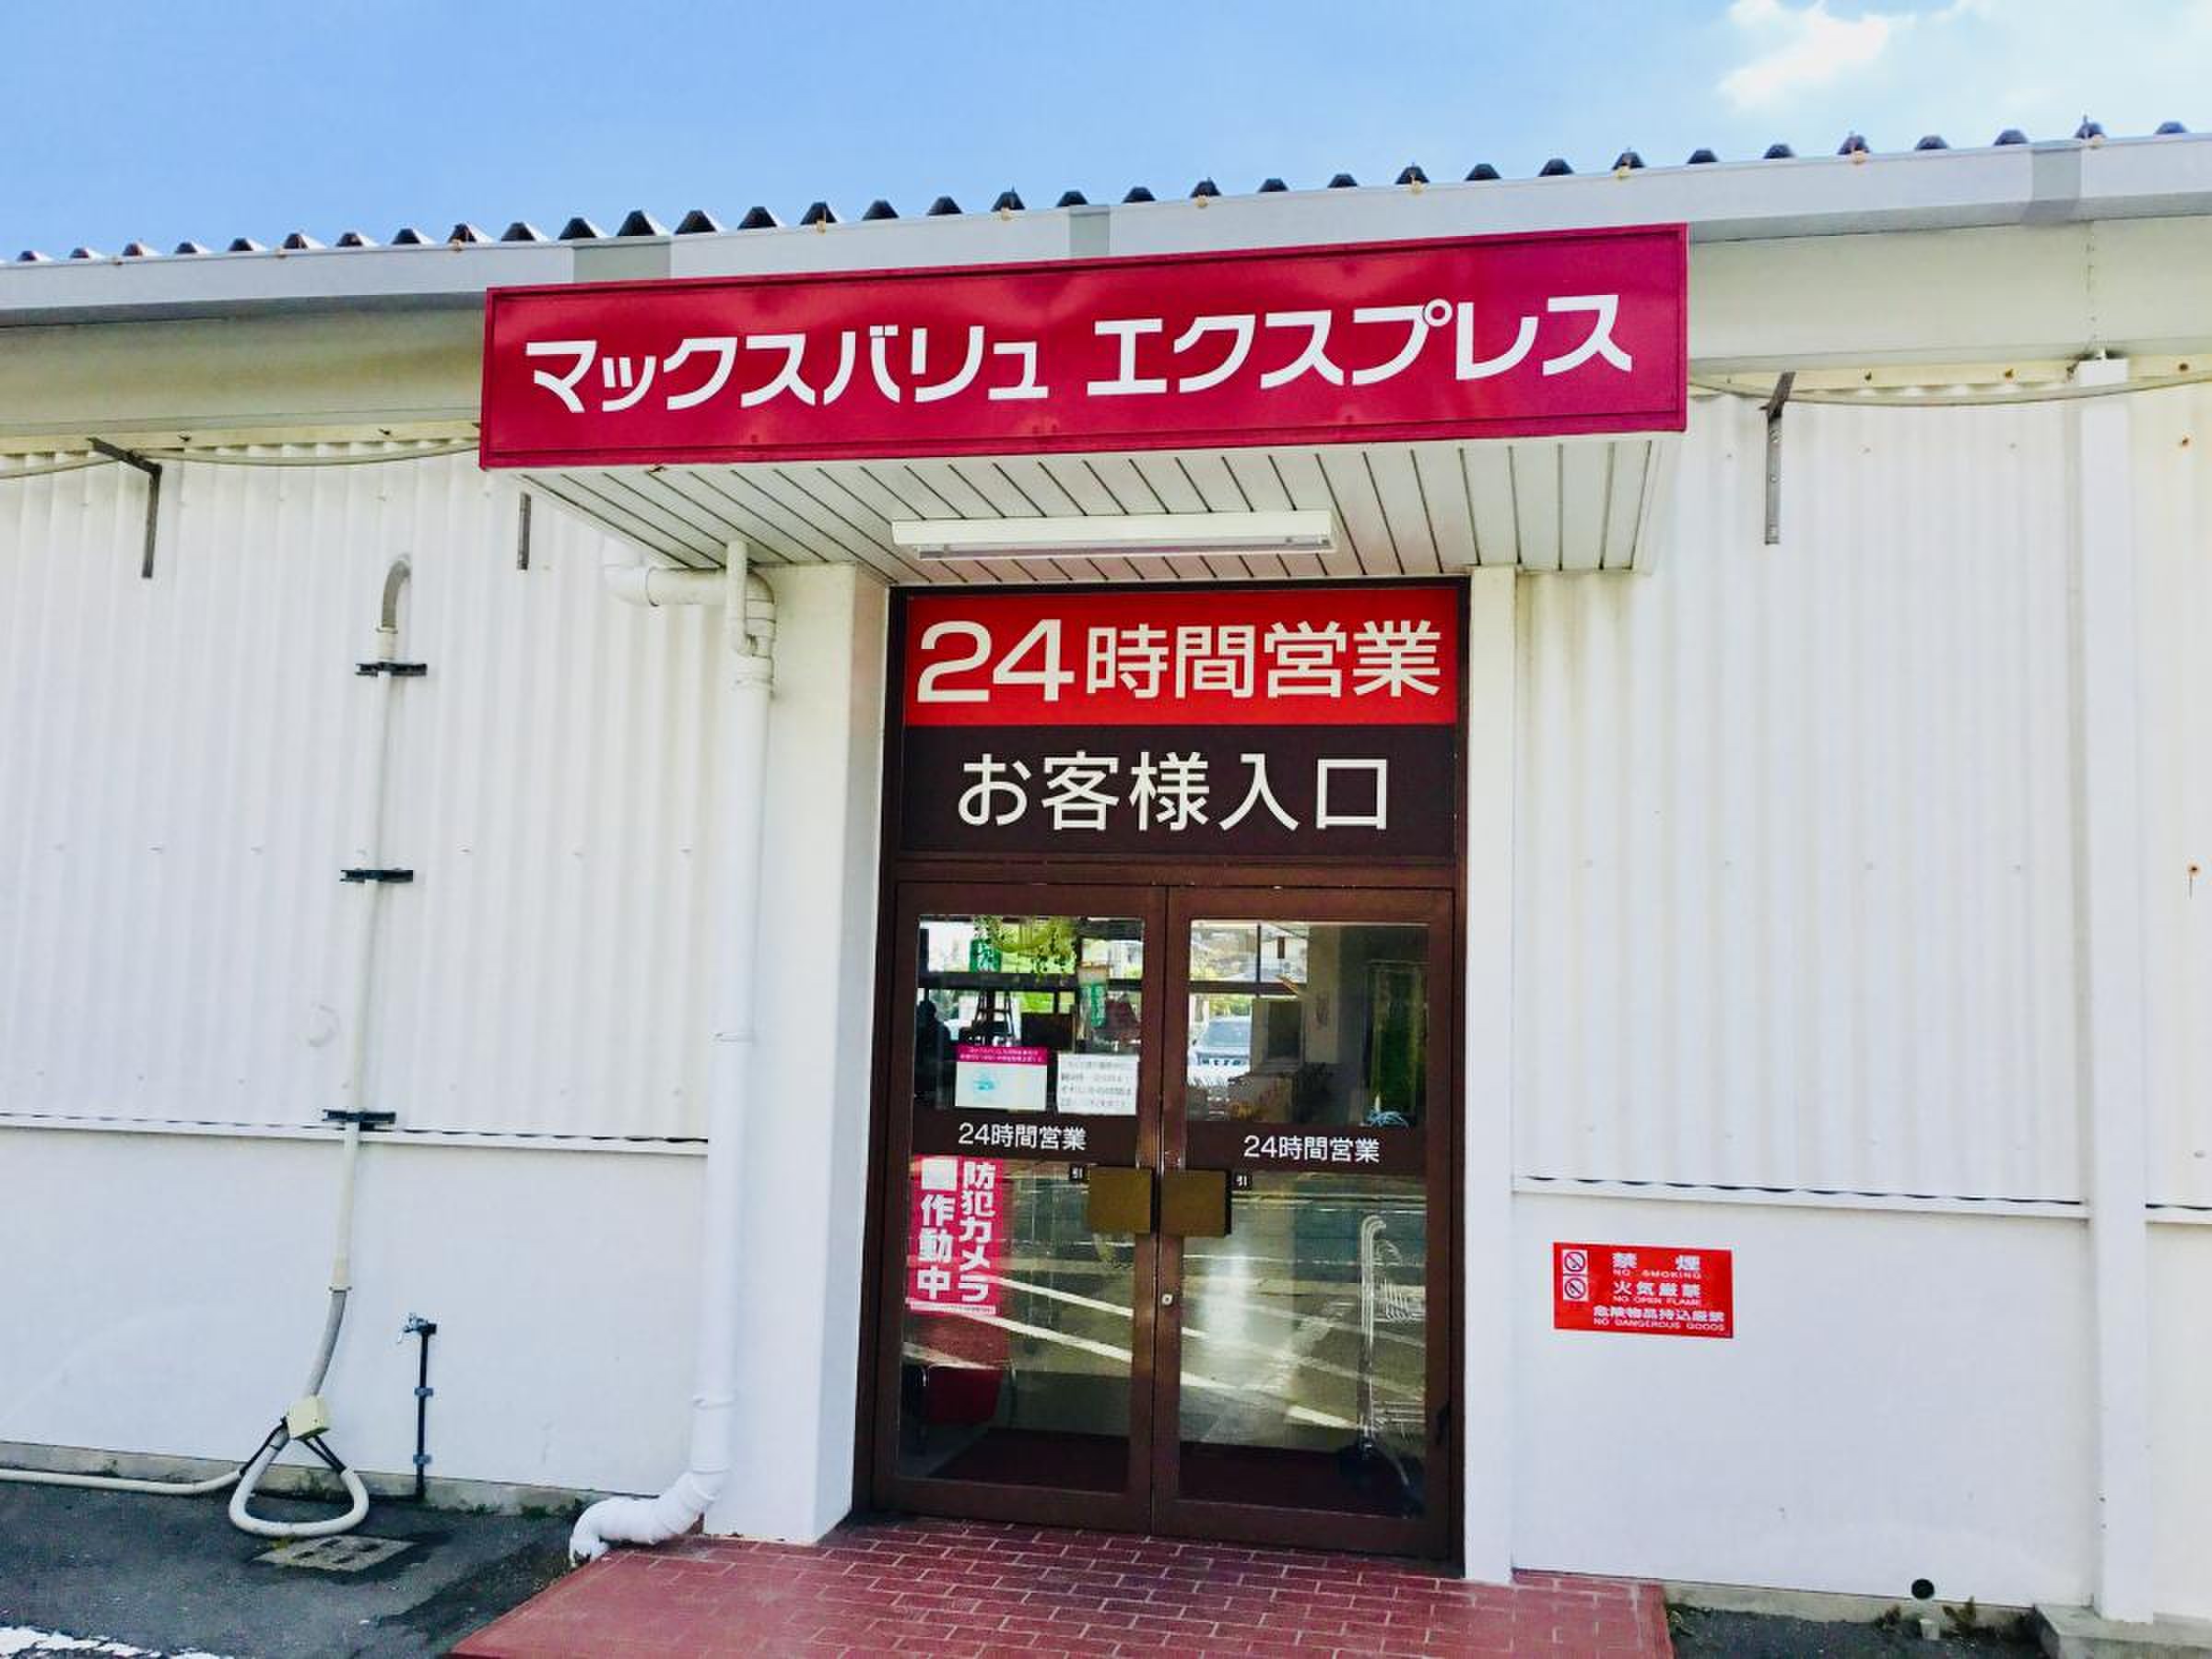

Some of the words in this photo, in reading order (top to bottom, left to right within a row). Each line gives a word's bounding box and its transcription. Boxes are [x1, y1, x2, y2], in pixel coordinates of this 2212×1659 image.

[526, 324, 1049, 414] マックスバリュ
[1087, 293, 1632, 396] エクスプレス
[917, 618, 1441, 702] 24時間営業
[958, 749, 1387, 831] お客様入口
[958, 1121, 1087, 1151] 24時間営業
[1244, 1135, 1381, 1163] 24時間営業
[959, 1160, 996, 1302] 防犯カメラ
[917, 1194, 956, 1300] 作動中
[1613, 1268, 1631, 1277] NO
[1642, 1270, 1702, 1279] SMOKING
[1613, 1295, 1629, 1303] NO
[1634, 1296, 1663, 1304] OPEN
[1614, 1280, 1701, 1299] 火気厳禁
[1594, 1317, 1609, 1325] NO
[1616, 1318, 1681, 1329] DANGEROUS
[1686, 1323, 1725, 1332] GOODS
